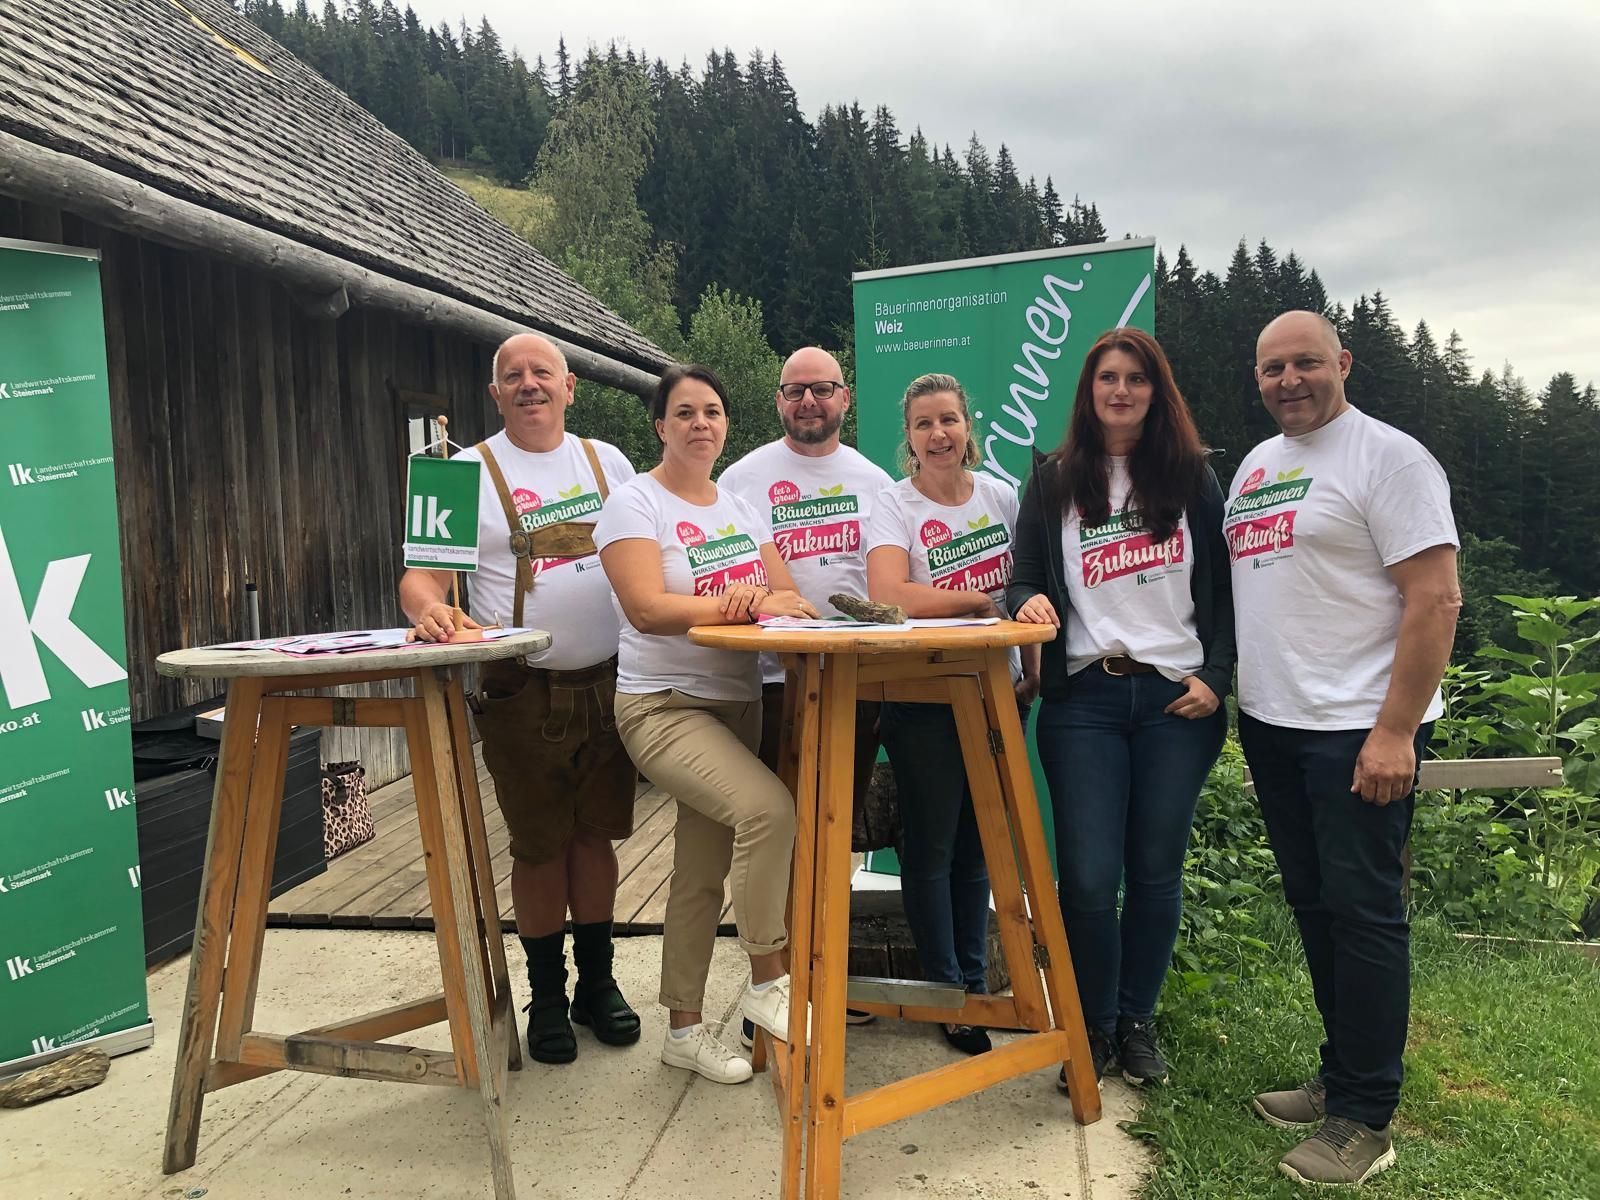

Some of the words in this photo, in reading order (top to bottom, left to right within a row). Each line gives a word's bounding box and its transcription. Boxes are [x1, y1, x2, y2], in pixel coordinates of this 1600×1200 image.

[875, 290, 1007, 317] Bäuerinnenorganisation
[875, 319, 904, 335] Weiz
[875, 336, 971, 353] www.baeuerinnen.at
[10, 374, 96, 390] Landwirtschaftskammer
[12, 387, 54, 398] Steiermark
[8, 463, 36, 486] lk
[36, 470, 79, 483] Steiermark
[774, 486, 791, 495] let's
[774, 490, 799, 503] grow!
[411, 495, 453, 539] lk
[519, 498, 600, 533] Bäuerinnen
[773, 500, 857, 522] Bäuerinnen
[924, 525, 941, 537] let's
[927, 531, 950, 548] grow!
[1228, 515, 1290, 564] Zukunft
[688, 539, 755, 565] Bäuerinnen
[775, 524, 858, 565] Zukunft
[929, 530, 1007, 567] Bäuerinnen
[1084, 536, 1181, 590] Zukunft
[81, 708, 108, 732] lk
[104, 787, 131, 811] lk
[8, 847, 94, 882] Landwirtschaftskammer
[10, 869, 53, 890] Steiermark
[33, 925, 118, 963] Landwirtschaftskammer
[6, 955, 35, 981] lk
[35, 949, 77, 971] Steiermark
[57, 1001, 140, 1042] Landwirtschaftskammer
[31, 1035, 56, 1054] lk
